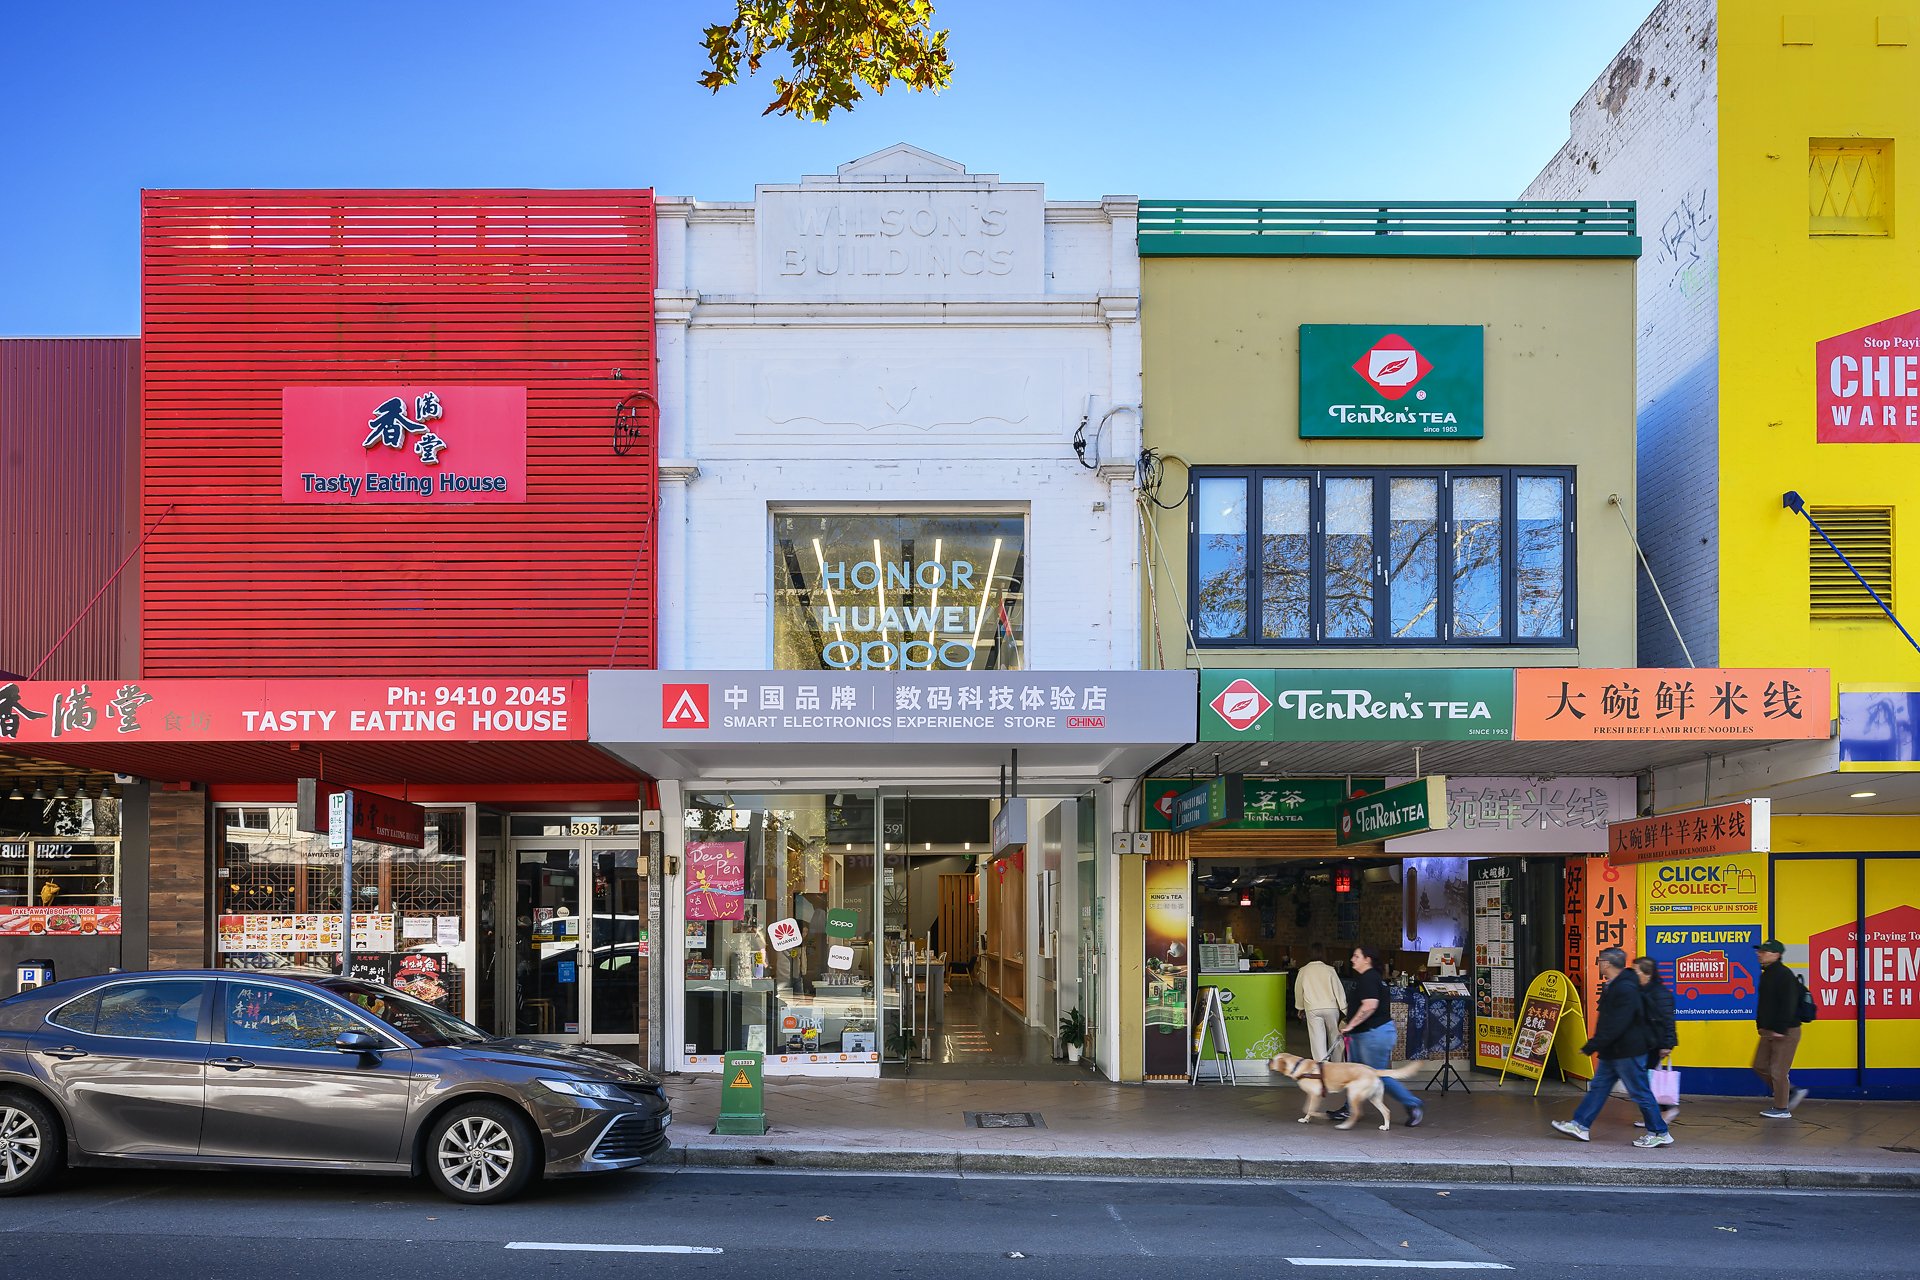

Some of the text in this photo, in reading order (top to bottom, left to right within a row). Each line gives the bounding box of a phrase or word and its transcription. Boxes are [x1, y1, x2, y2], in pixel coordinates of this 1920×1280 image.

[799, 205, 1008, 237] WILSON'S
[1863, 336, 1920, 350] Stop Payi
[1830, 355, 1918, 398] CHE
[1418, 412, 1458, 424] TEA
[1831, 405, 1918, 426] WARE
[301, 472, 507, 497] Tasty Eating House
[822, 561, 974, 590] HONOR
[822, 606, 976, 633] HUAWEI
[822, 640, 976, 671] oppo
[387, 686, 567, 706] Ph: 9410 2045
[724, 685, 1108, 711] 中国品牌 数码科技体验店
[1545, 680, 1803, 721] 大碗鲜米线
[1428, 701, 1492, 719] TEA
[242, 710, 567, 732] TASTY EATING HOUSE
[723, 716, 1104, 728] SMART ELECTRONICS EXPERIENCE STORE CHINA
[1593, 726, 1754, 734] FRESH BEEF LAMB RICE NOODLES
[332, 795, 344, 809] 1P
[1402, 803, 1425, 823] TEA
[571, 823, 599, 836] 393
[884, 823, 903, 835] 391
[690, 849, 723, 863] Deco
[1679, 847, 1691, 855] RICE
[1692, 844, 1716, 854] NOODLES
[716, 859, 741, 876] Pen
[1658, 866, 1721, 882] CLICK
[830, 919, 854, 928] oppo
[776, 936, 799, 947] HUAWEI
[1655, 931, 1752, 943] FAST DELIVERY
[1847, 932, 1871, 943] Stp
[1873, 931, 1907, 943] Paying
[1679, 961, 1725, 972] CHEMIST
[25, 971, 33, 980] P
[1820, 988, 1920, 1006] WAREH
